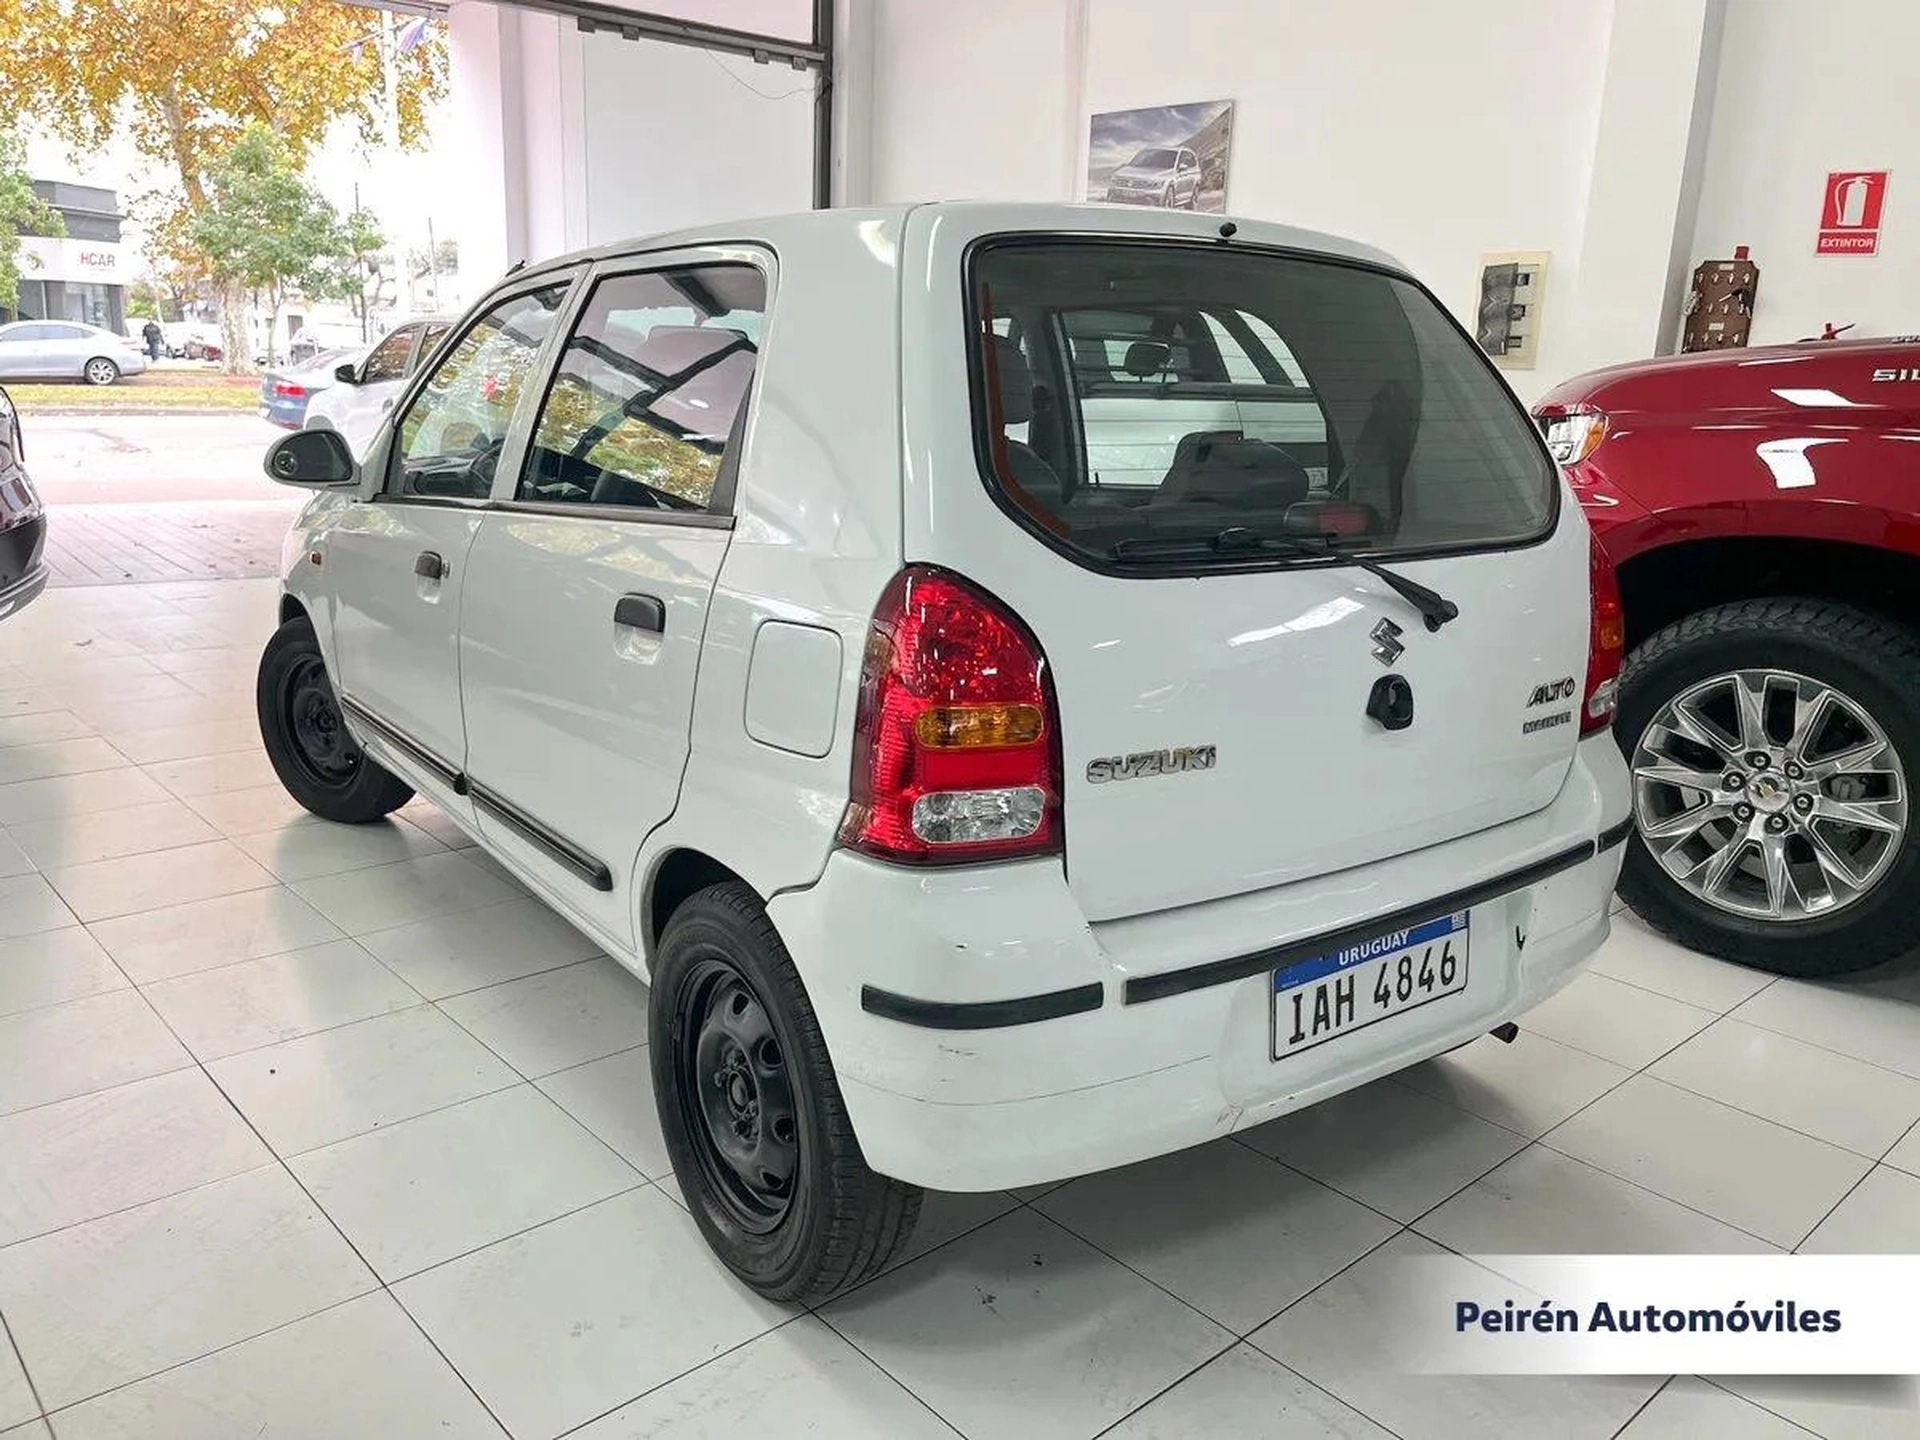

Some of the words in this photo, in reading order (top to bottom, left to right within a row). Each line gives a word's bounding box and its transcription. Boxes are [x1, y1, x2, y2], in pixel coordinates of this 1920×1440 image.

[1820, 237, 1875, 248] EXTINTOR
[80, 252, 116, 267] HCAR
[1526, 677, 1575, 707] ALTO
[1086, 745, 1217, 784] SUZUKI
[1338, 929, 1411, 966] URUGUAY
[1289, 973, 1355, 1046] IAH
[1373, 939, 1457, 1009] 4846
